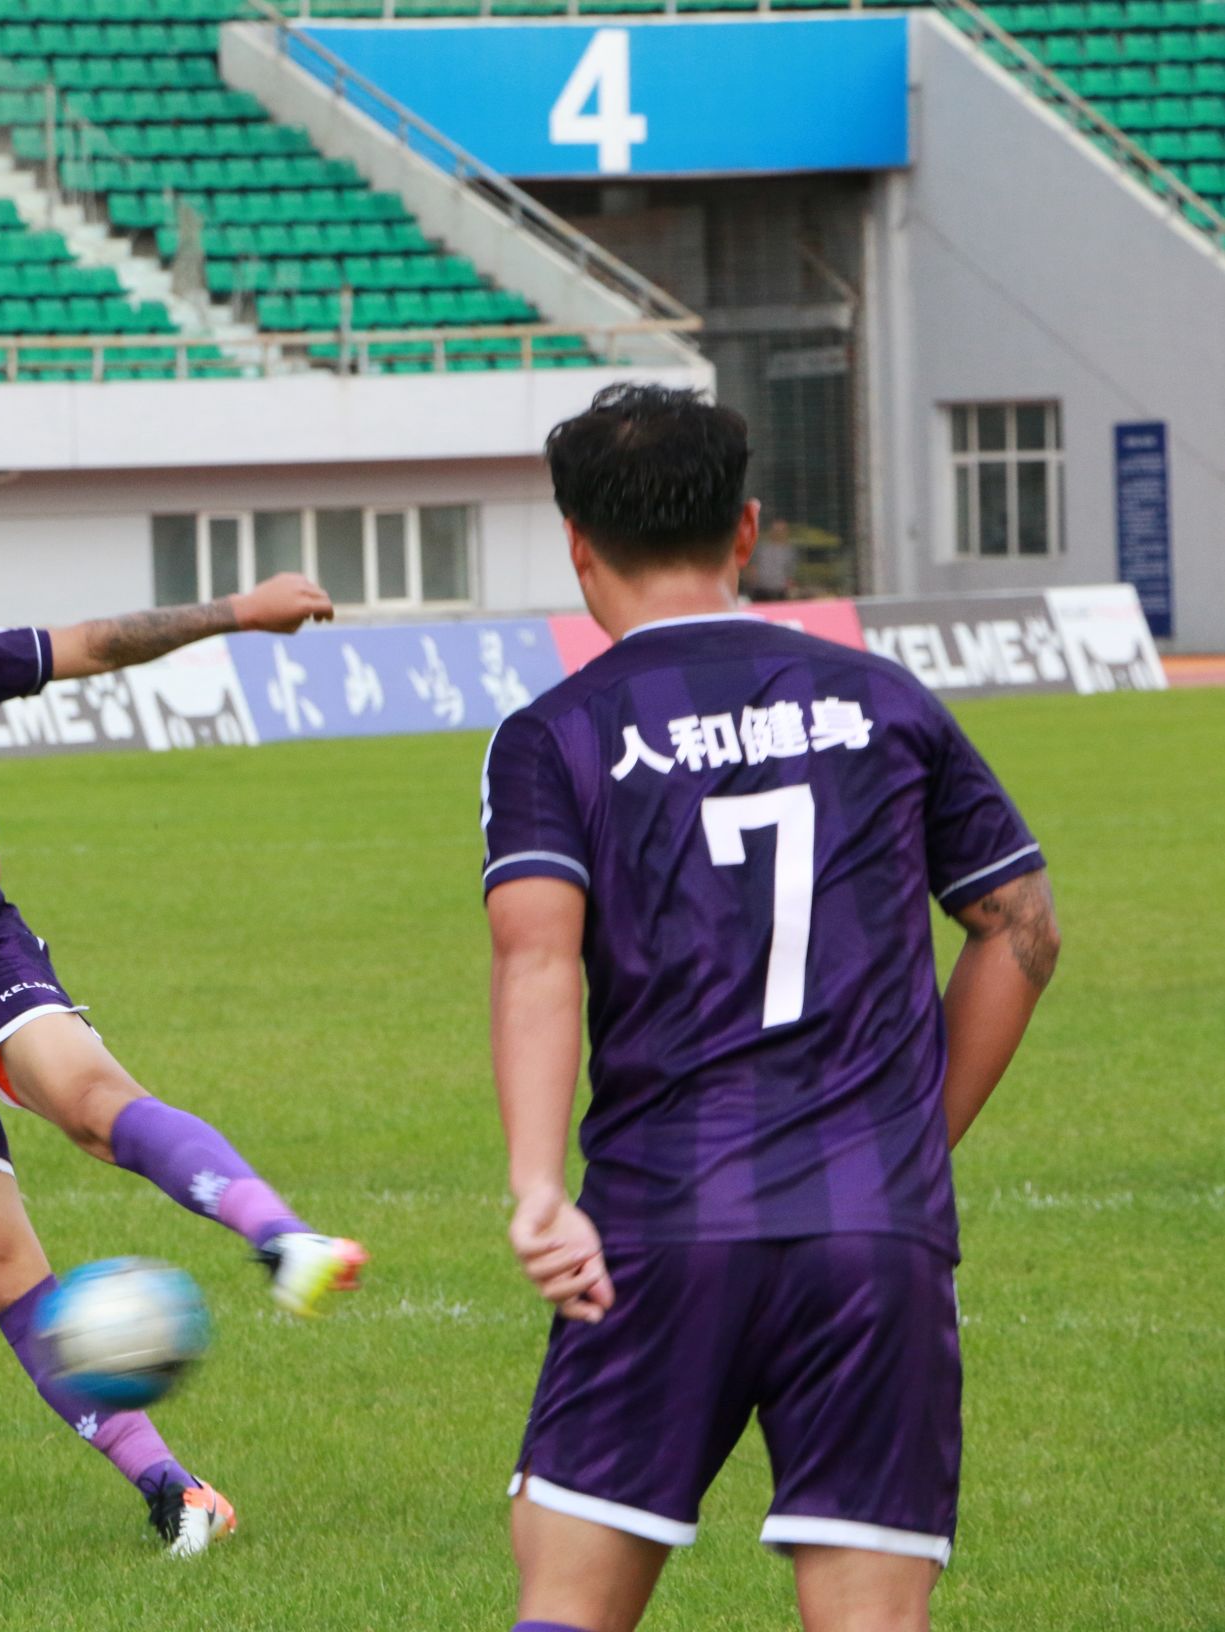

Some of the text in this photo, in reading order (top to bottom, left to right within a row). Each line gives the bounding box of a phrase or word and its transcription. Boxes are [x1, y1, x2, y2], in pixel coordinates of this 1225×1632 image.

[549, 28, 647, 173] 4
[866, 619, 1036, 689] KELME
[610, 697, 874, 781] 人和健身
[702, 784, 816, 1030] 7
[0, 981, 60, 1002] KELME
